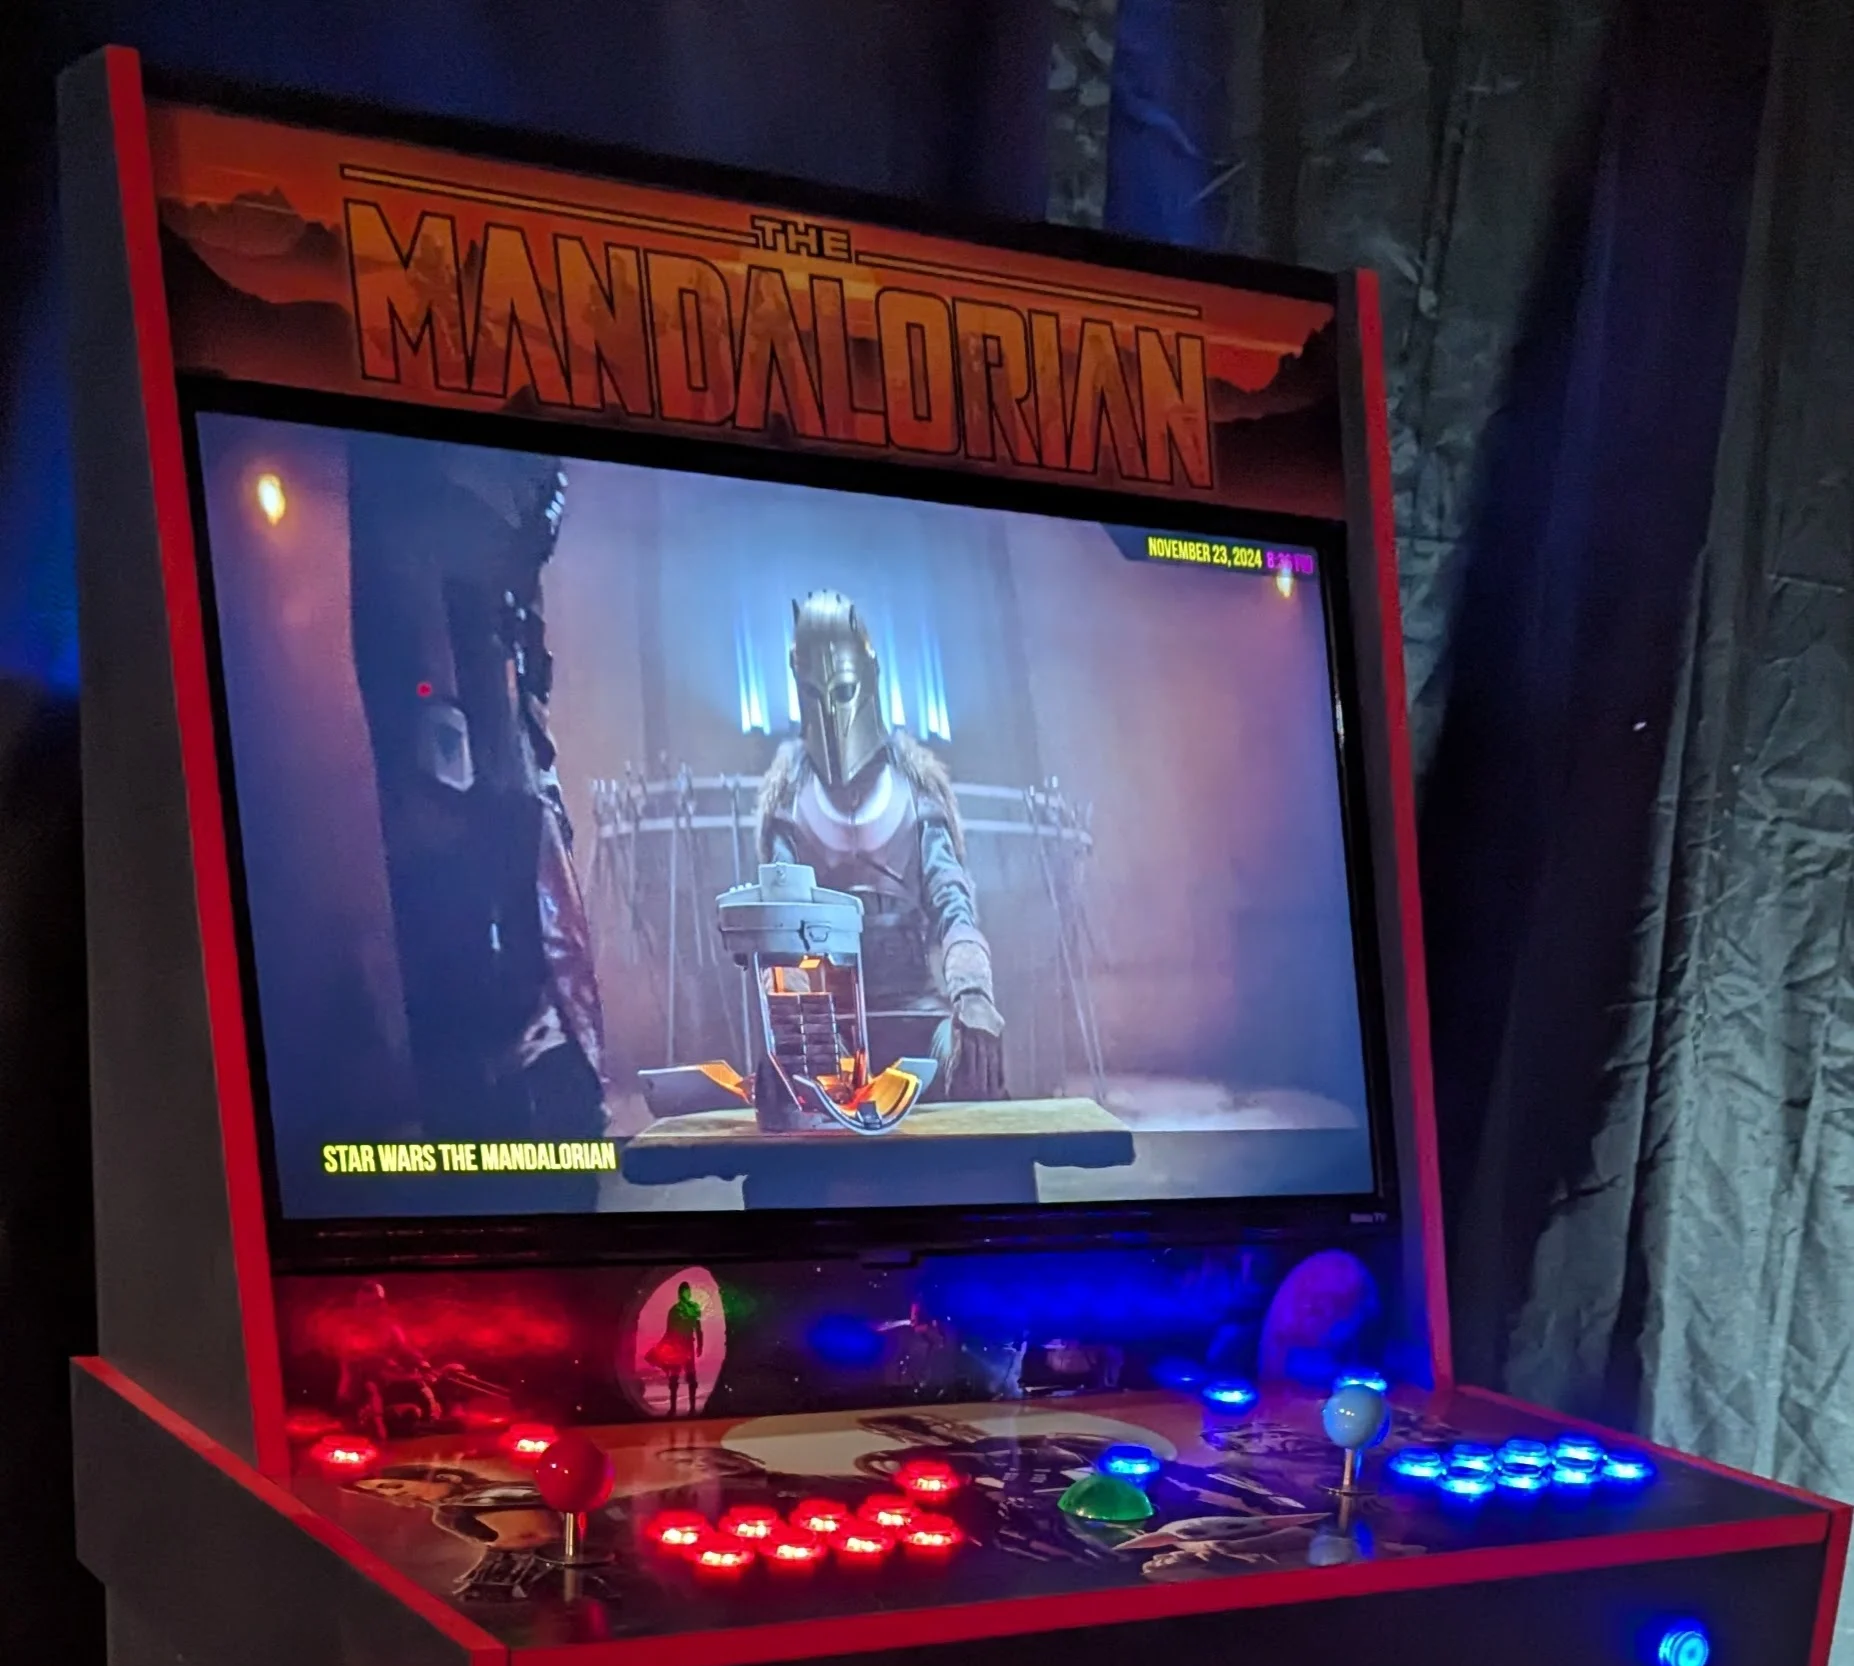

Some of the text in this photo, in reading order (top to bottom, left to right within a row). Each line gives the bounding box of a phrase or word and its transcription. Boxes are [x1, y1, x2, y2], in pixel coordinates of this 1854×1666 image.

[750, 214, 852, 264] THE
[343, 198, 1215, 490] MANDALORIAN
[1147, 536, 1211, 563] NOVEMBER
[1211, 544, 1232, 568] 23,
[1232, 546, 1263, 569] 2024
[323, 1142, 617, 1173] STAR WARS THE MANDALORIAN
